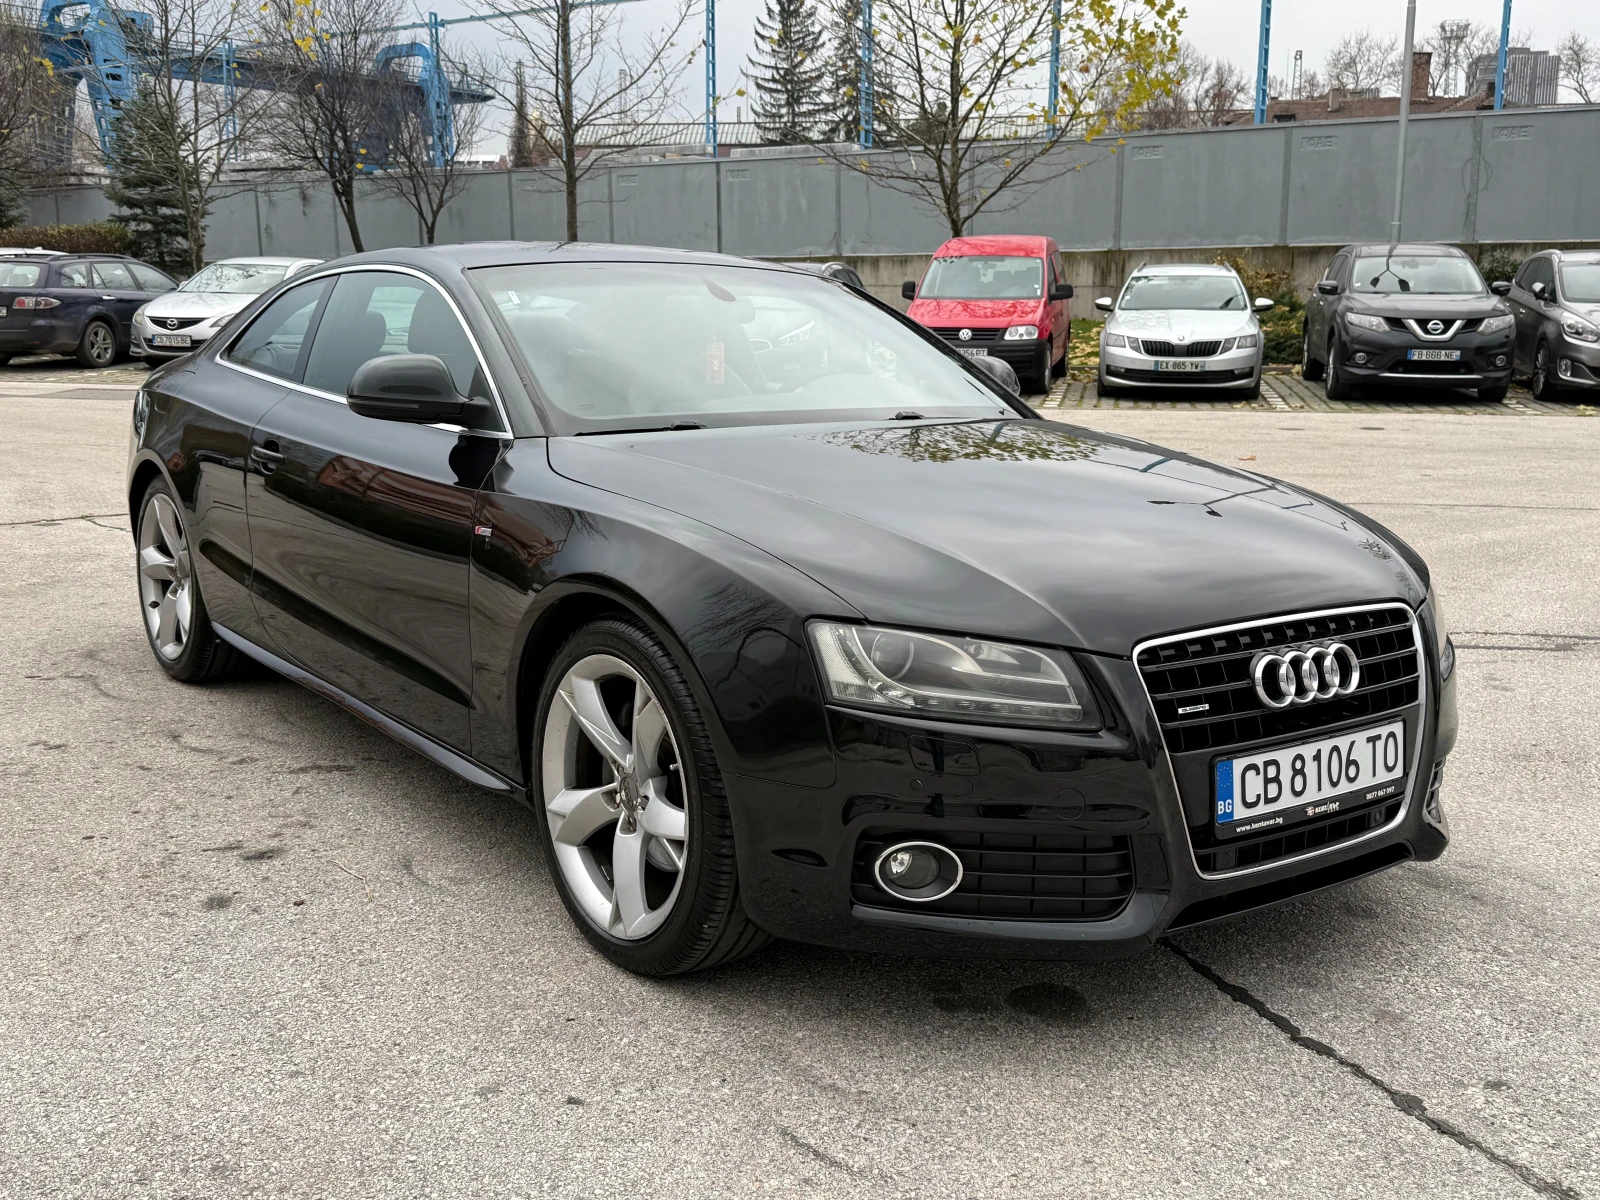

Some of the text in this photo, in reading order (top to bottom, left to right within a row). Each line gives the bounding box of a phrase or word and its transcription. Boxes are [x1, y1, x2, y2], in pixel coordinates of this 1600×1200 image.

[1240, 730, 1399, 809] CB 8106 TO
[1217, 798, 1233, 815] BG
